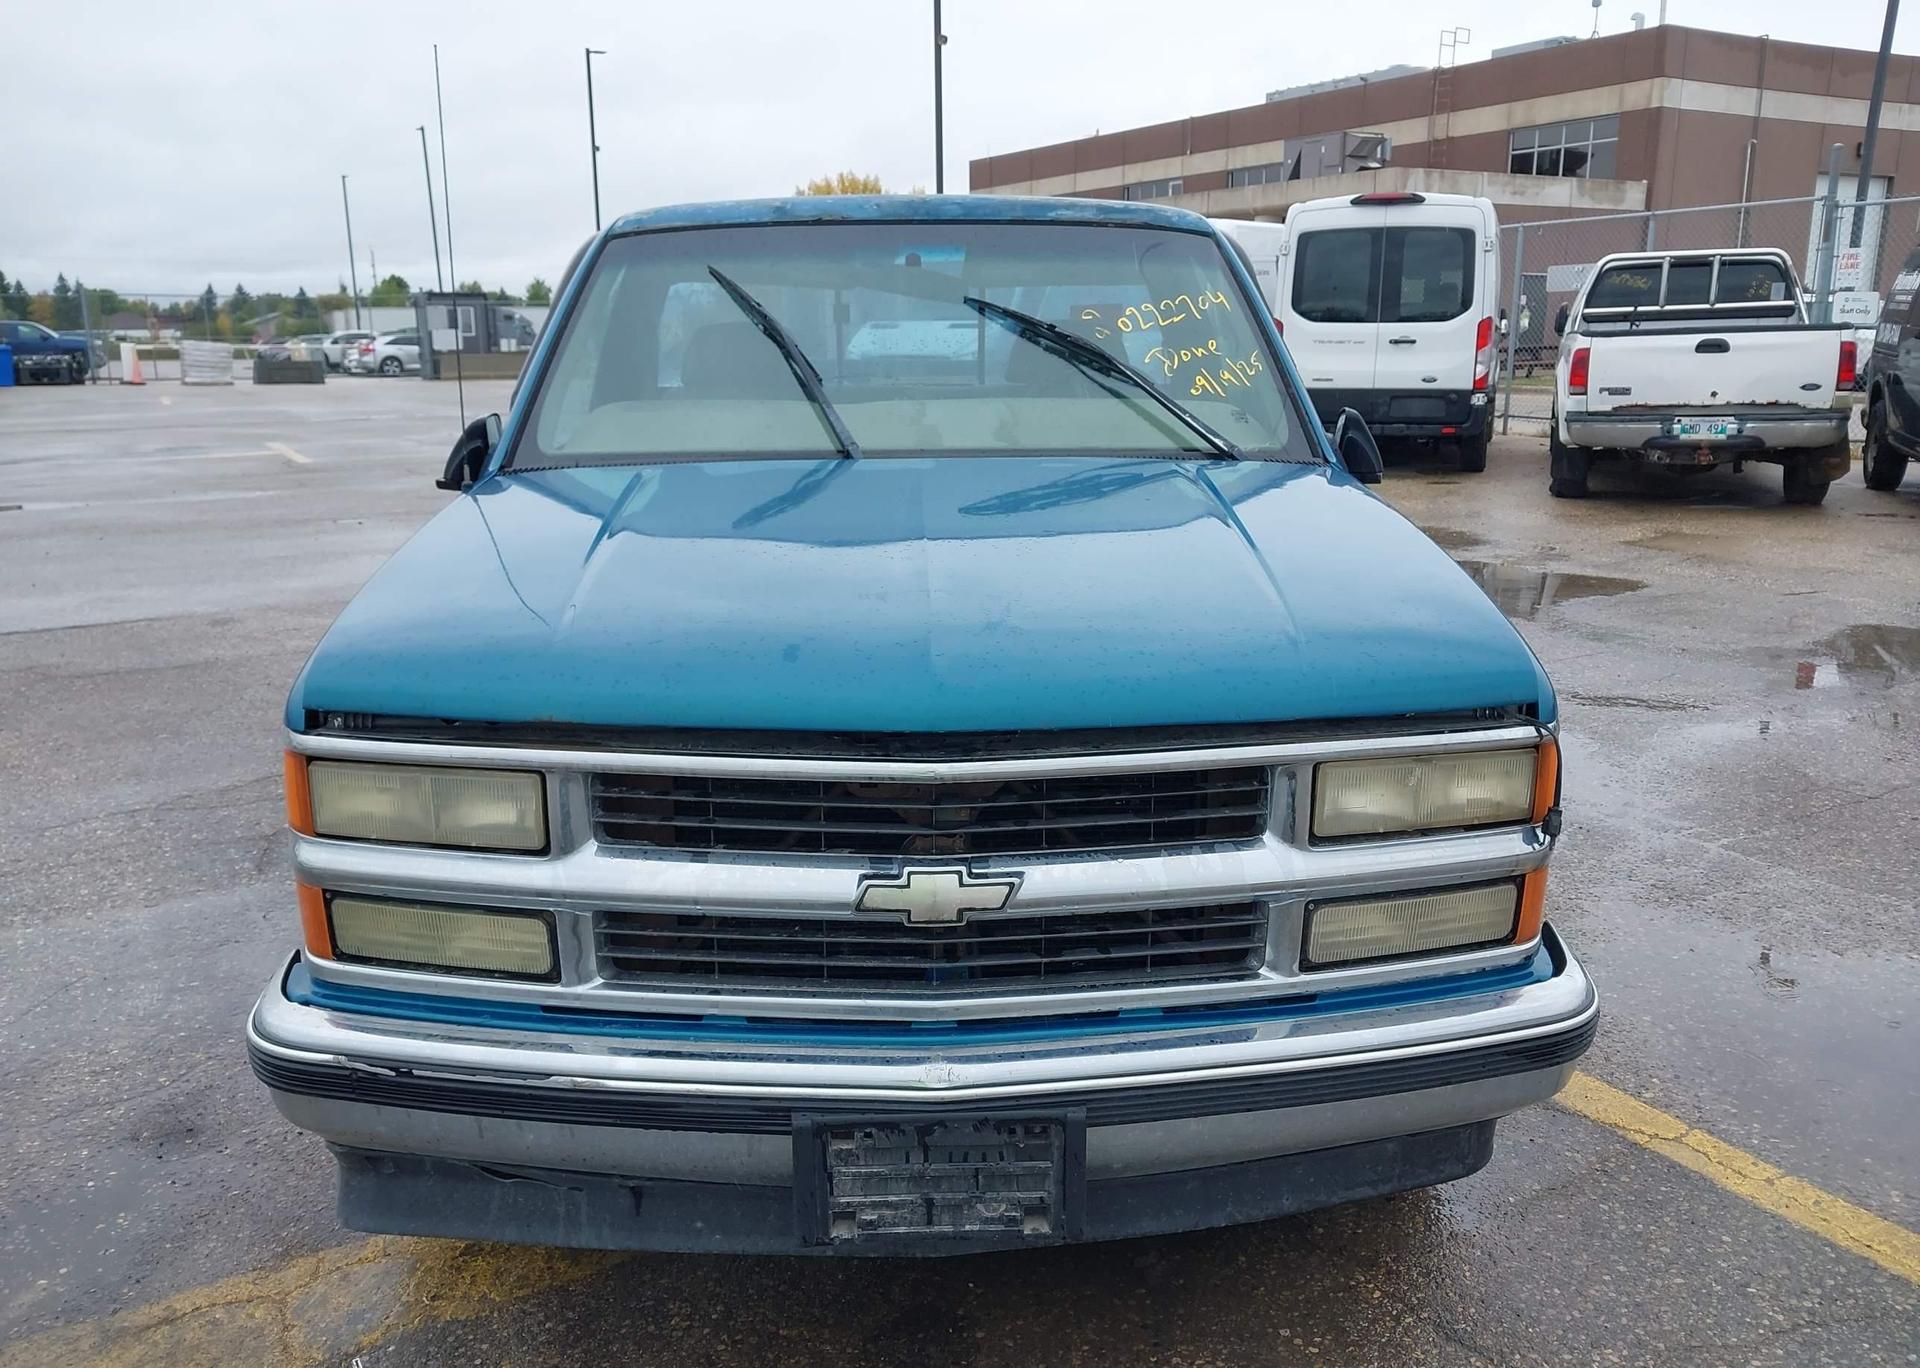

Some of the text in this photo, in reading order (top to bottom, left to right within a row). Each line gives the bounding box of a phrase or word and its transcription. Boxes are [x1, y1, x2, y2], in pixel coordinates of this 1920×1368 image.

[1842, 252, 1861, 260] FIRE
[1840, 261, 1860, 270] LANE
[1840, 306, 1871, 316] Staff Only
[1145, 340, 1222, 377] Done
